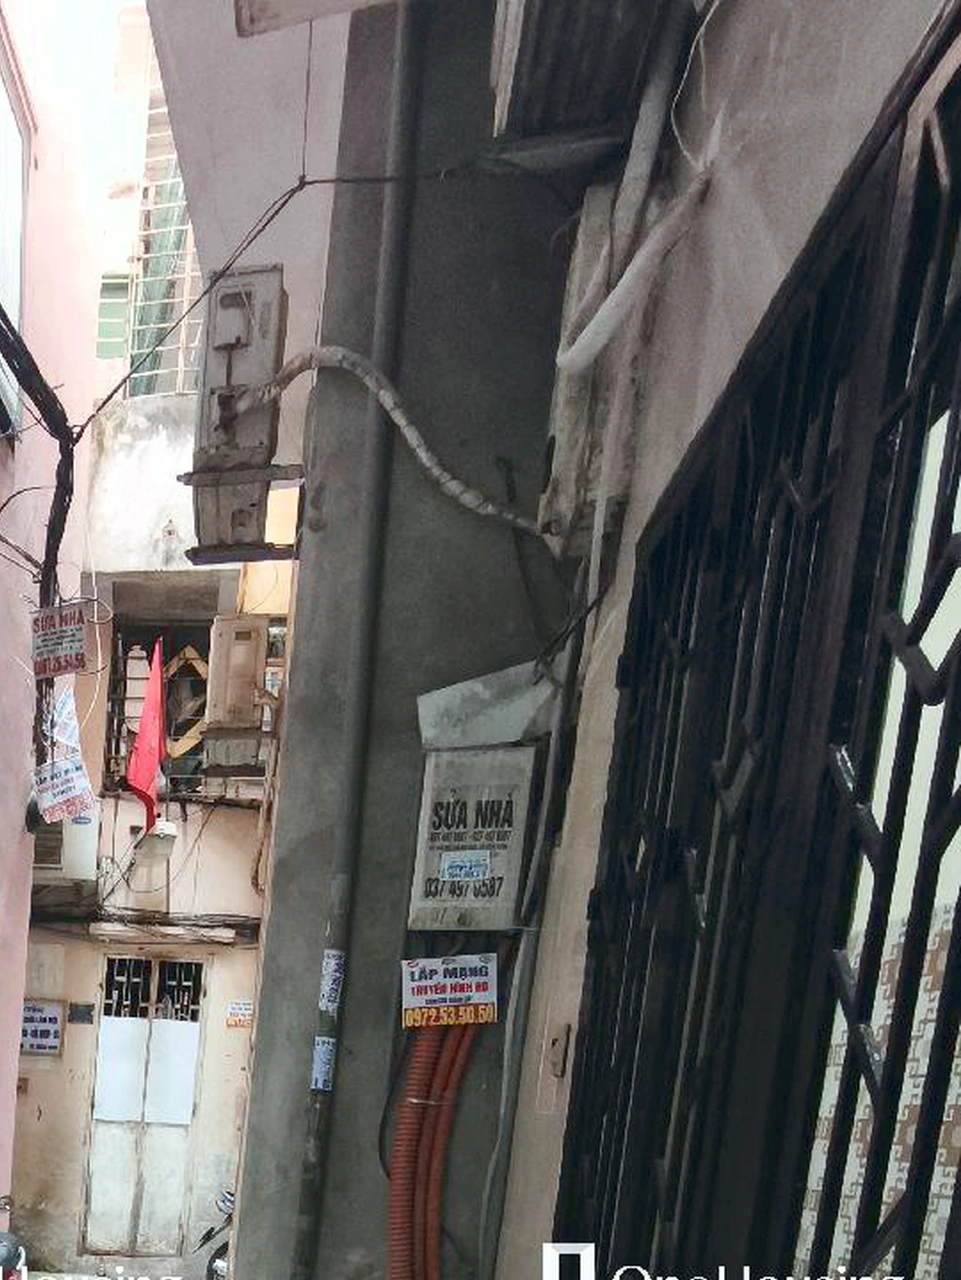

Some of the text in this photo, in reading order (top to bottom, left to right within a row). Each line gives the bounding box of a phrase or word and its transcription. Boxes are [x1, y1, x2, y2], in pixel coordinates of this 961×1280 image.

[432, 788, 514, 830] SỬA NHÀ
[443, 965, 489, 981] MẠNG
